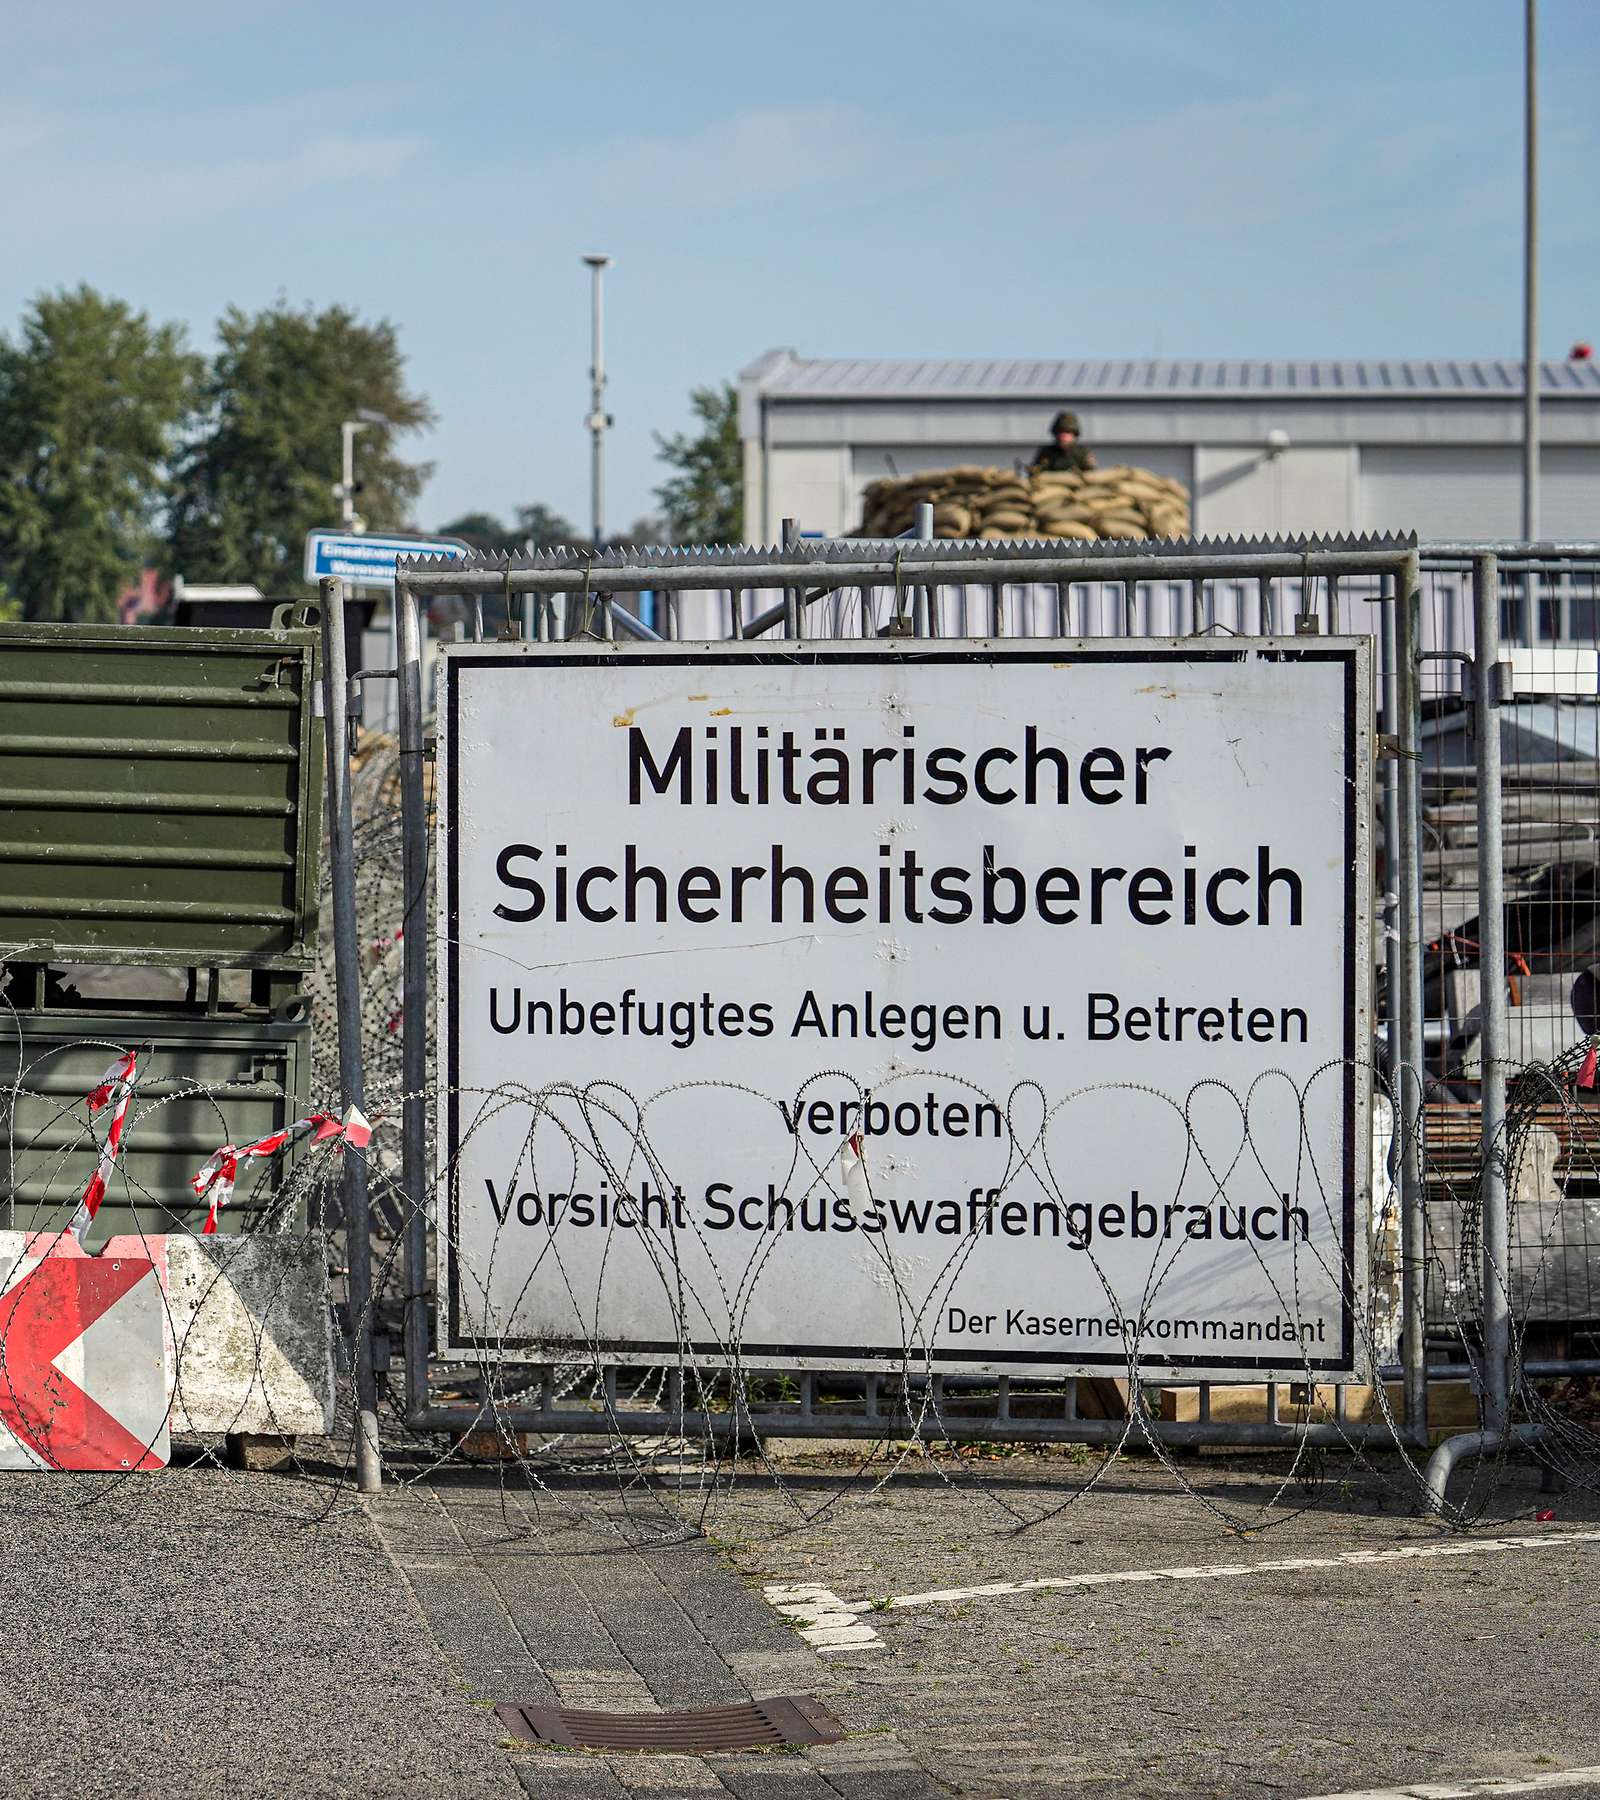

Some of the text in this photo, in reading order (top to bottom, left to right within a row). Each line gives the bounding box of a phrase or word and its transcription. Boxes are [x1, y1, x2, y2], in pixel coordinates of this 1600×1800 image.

[627, 725, 1173, 807] Militärischer
[491, 843, 1304, 927] Sicherheitsbereich
[488, 987, 1309, 1052] Unbefugtes Anlegen u. Betreten
[777, 1088, 1002, 1138] verboten
[484, 1178, 1311, 1250] Vorsicht Schusswaffengebrauch
[947, 1307, 1329, 1344] Der Kasernenkommandant
